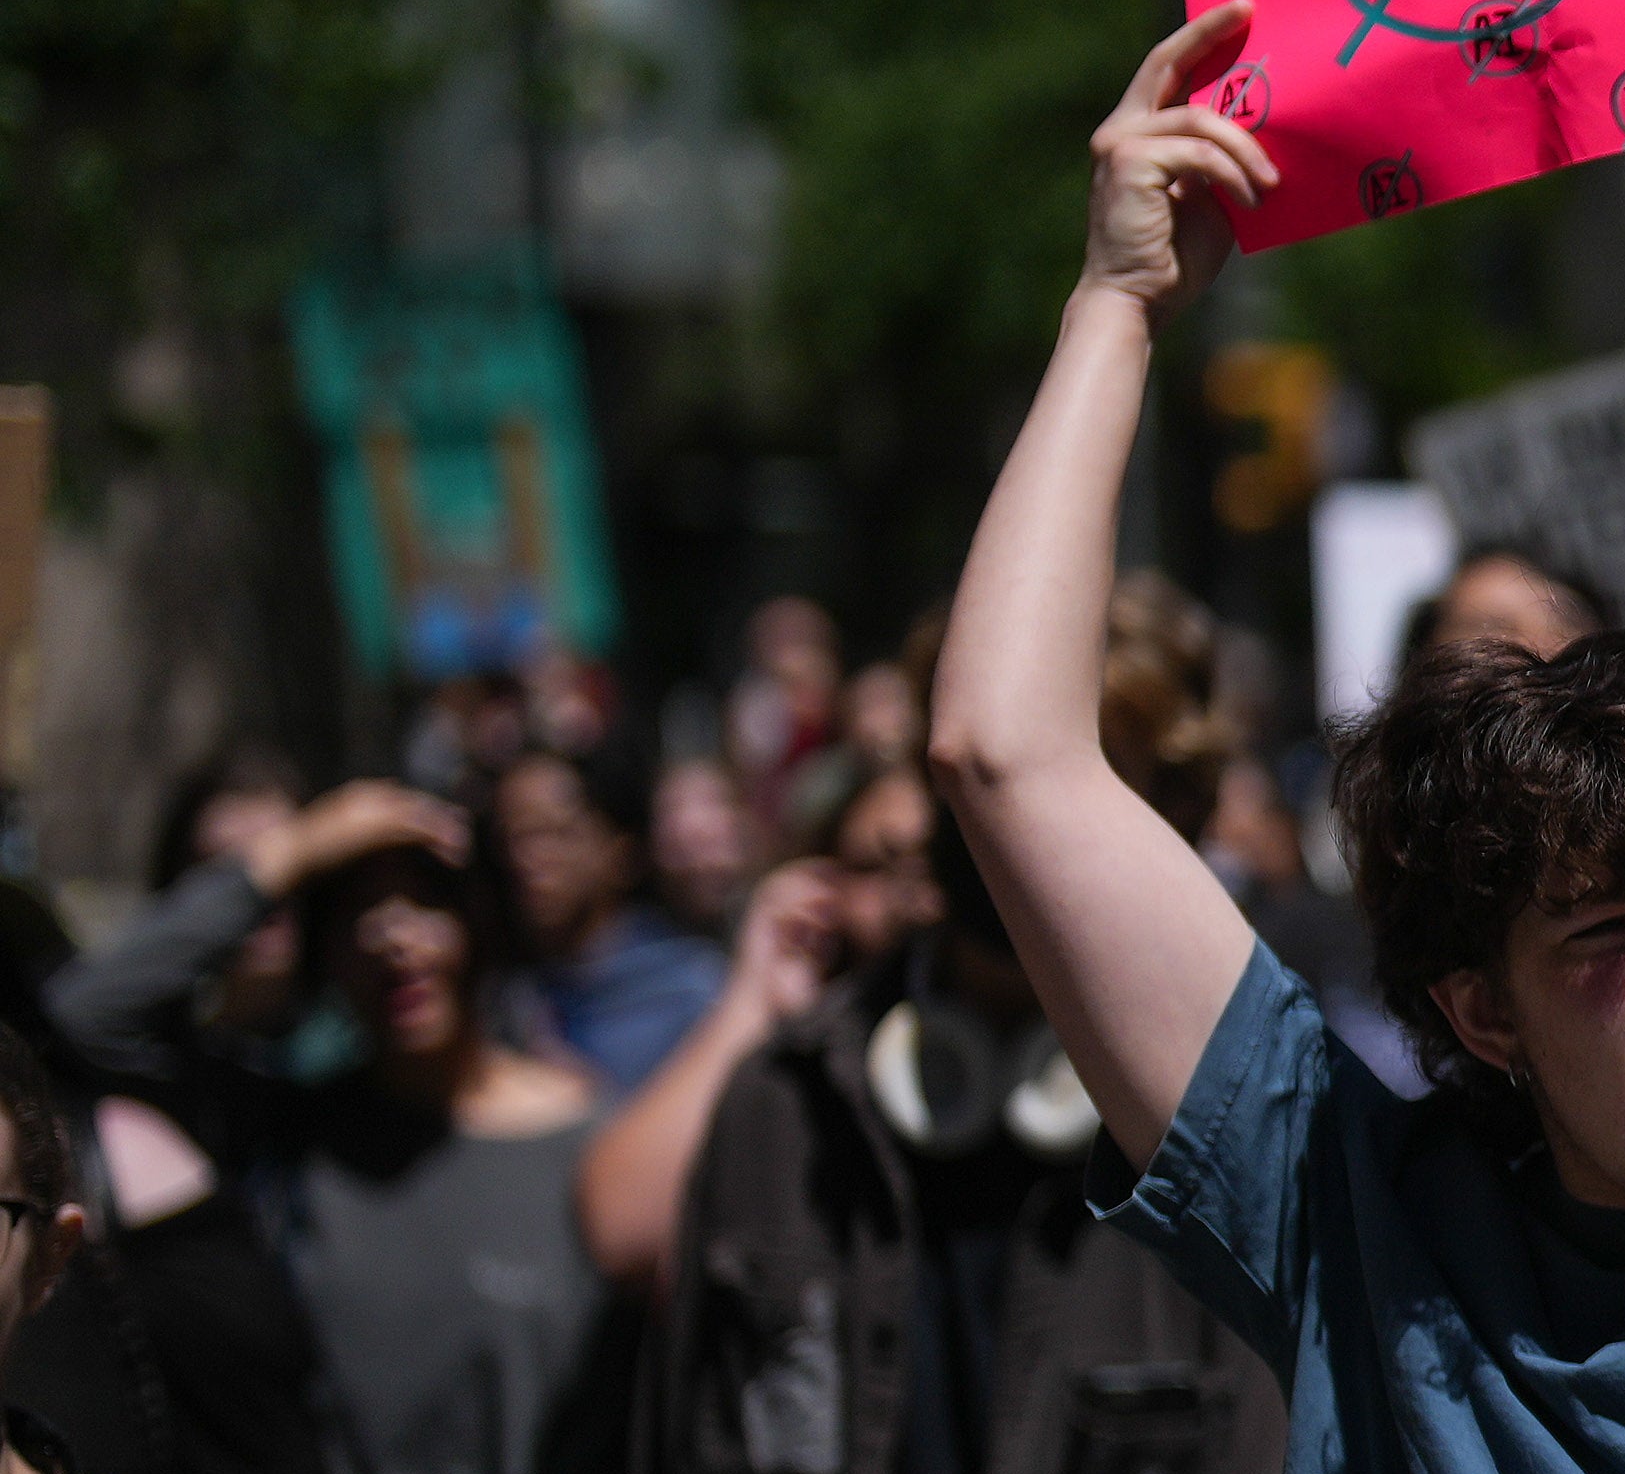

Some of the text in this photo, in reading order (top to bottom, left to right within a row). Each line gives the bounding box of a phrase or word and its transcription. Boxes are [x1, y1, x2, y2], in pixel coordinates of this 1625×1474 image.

[1472, 9, 1522, 62] AI
[1219, 76, 1254, 119] AI
[1370, 171, 1408, 216] AI
